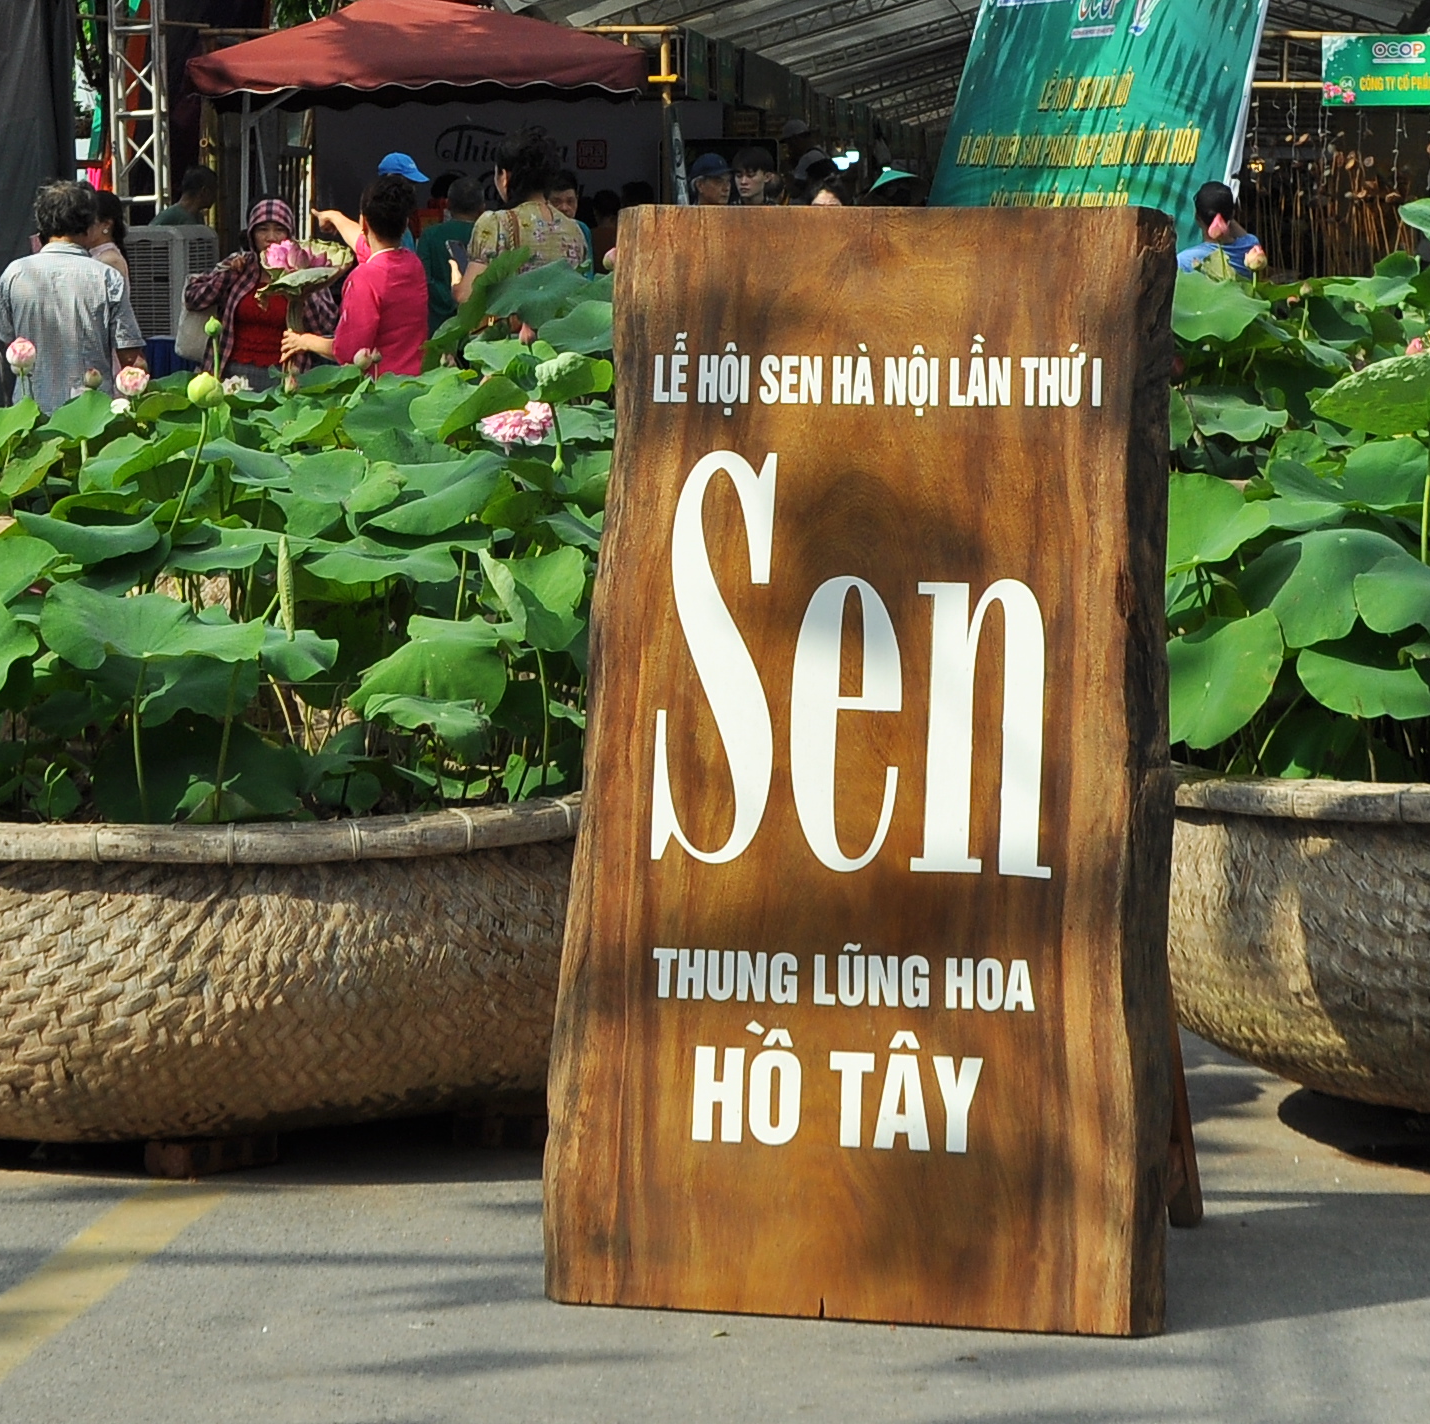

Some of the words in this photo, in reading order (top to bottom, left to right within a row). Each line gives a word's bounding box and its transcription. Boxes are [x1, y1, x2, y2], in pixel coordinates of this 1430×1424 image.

[1359, 74, 1384, 91] CÔNG
[1372, 41, 1426, 58] OCOP
[653, 332, 689, 403] LỄ
[697, 342, 750, 416] HỘI
[759, 354, 823, 404] SEN
[831, 342, 875, 407] HÀ
[883, 344, 939, 417] NỘI
[949, 333, 1012, 407] LẦN
[1020, 342, 1088, 407] THỨ
[1091, 357, 1102, 407] I
[650, 450, 1052, 879] Sen
[652, 947, 799, 1005] THUNG
[813, 942, 931, 1009] LŨNG
[944, 956, 1036, 1012] HOA
[691, 1020, 803, 1146] HỒ
[829, 1030, 984, 1154] TÂY
